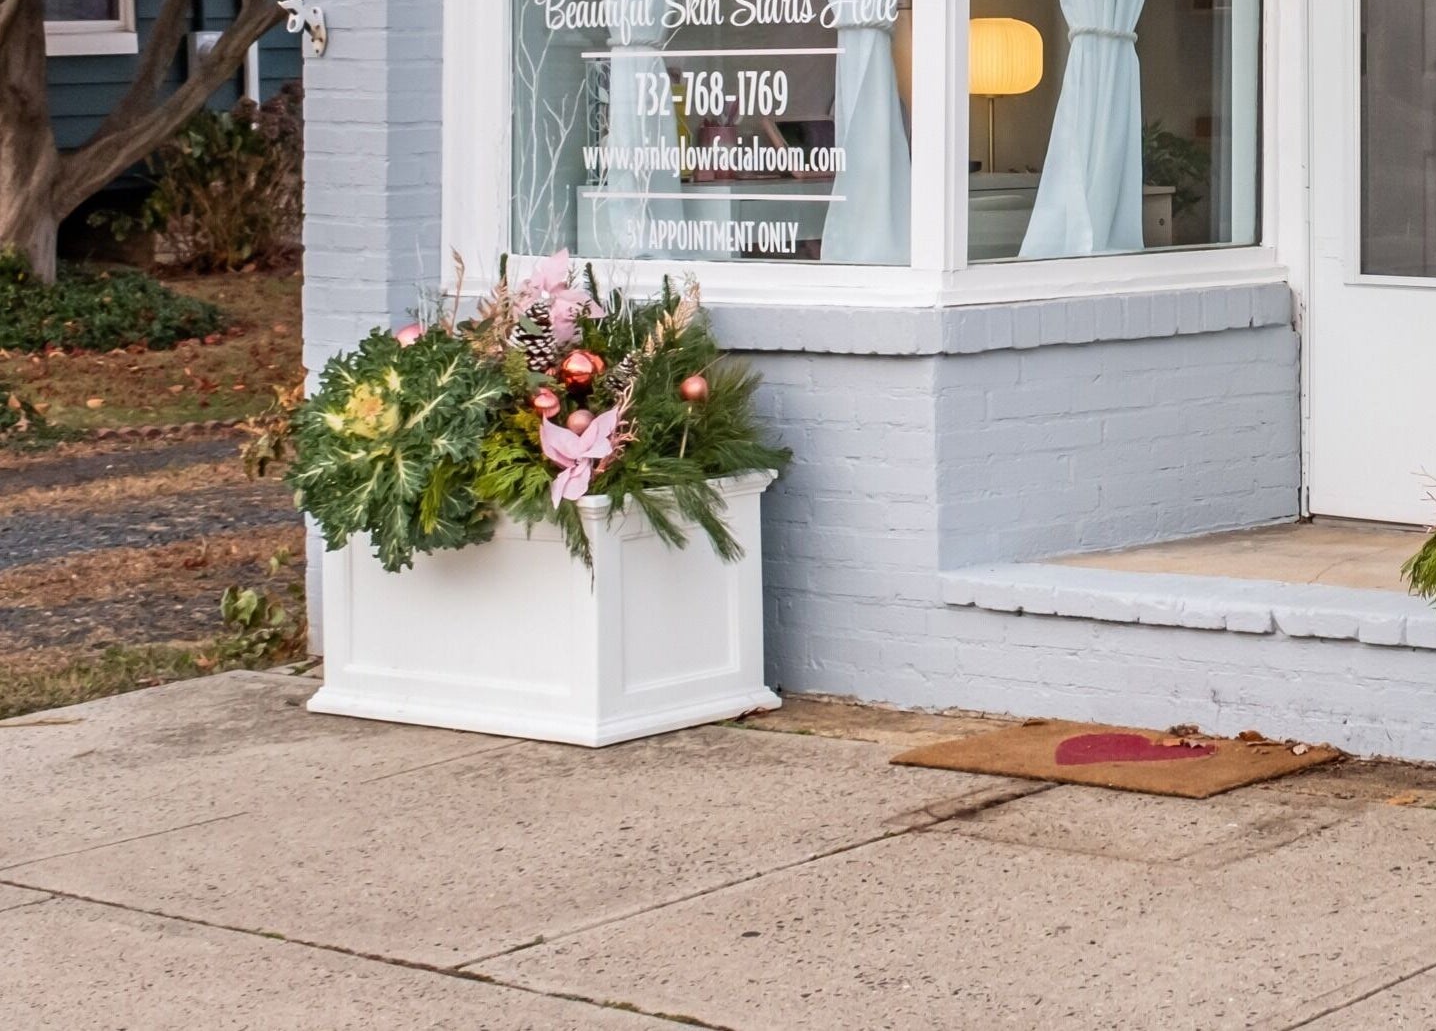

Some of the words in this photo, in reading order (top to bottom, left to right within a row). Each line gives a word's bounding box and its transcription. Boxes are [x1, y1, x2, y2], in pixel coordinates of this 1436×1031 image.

[635, 70, 789, 118] 732-768-1769
[582, 135, 847, 178] www.pinkglowfacialroom.com
[649, 219, 755, 253] APPOINTMENT
[757, 221, 799, 254] ONLY
